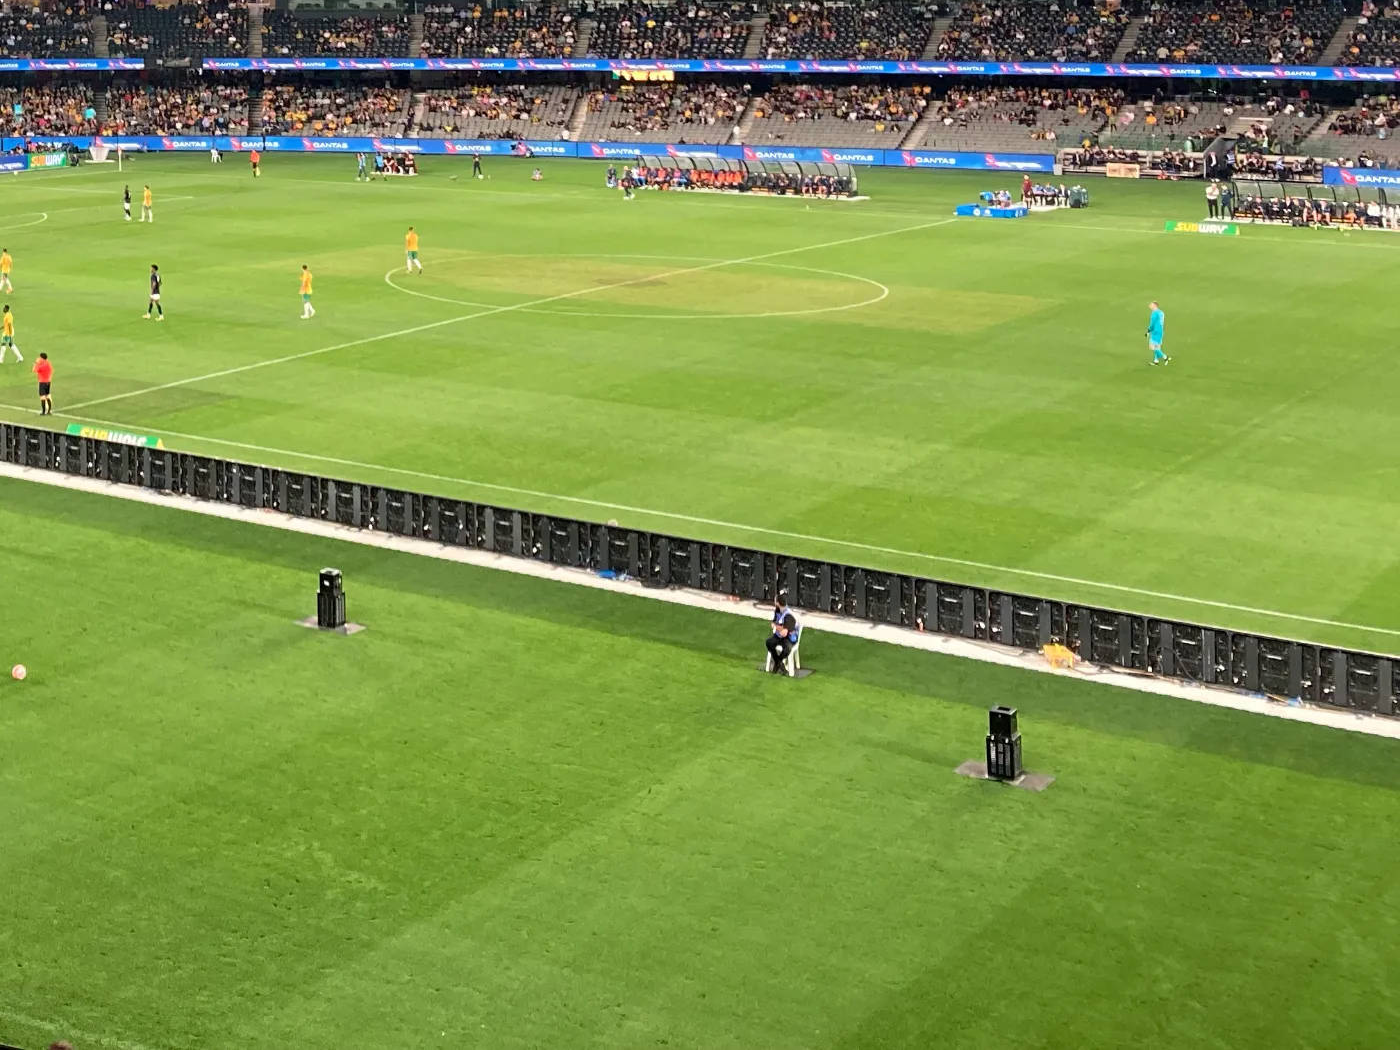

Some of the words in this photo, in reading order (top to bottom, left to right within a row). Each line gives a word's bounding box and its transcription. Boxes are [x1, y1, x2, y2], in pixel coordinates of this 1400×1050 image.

[173, 141, 207, 149] QANTAS
[312, 142, 348, 150] QANTAS
[602, 147, 640, 156] QANTAS
[755, 151, 795, 161] QANTAS
[31, 153, 65, 167] SUBWAY
[834, 153, 874, 162] QANTAS
[915, 157, 955, 166] QANTAS
[1174, 222, 1228, 234] SUBWAY
